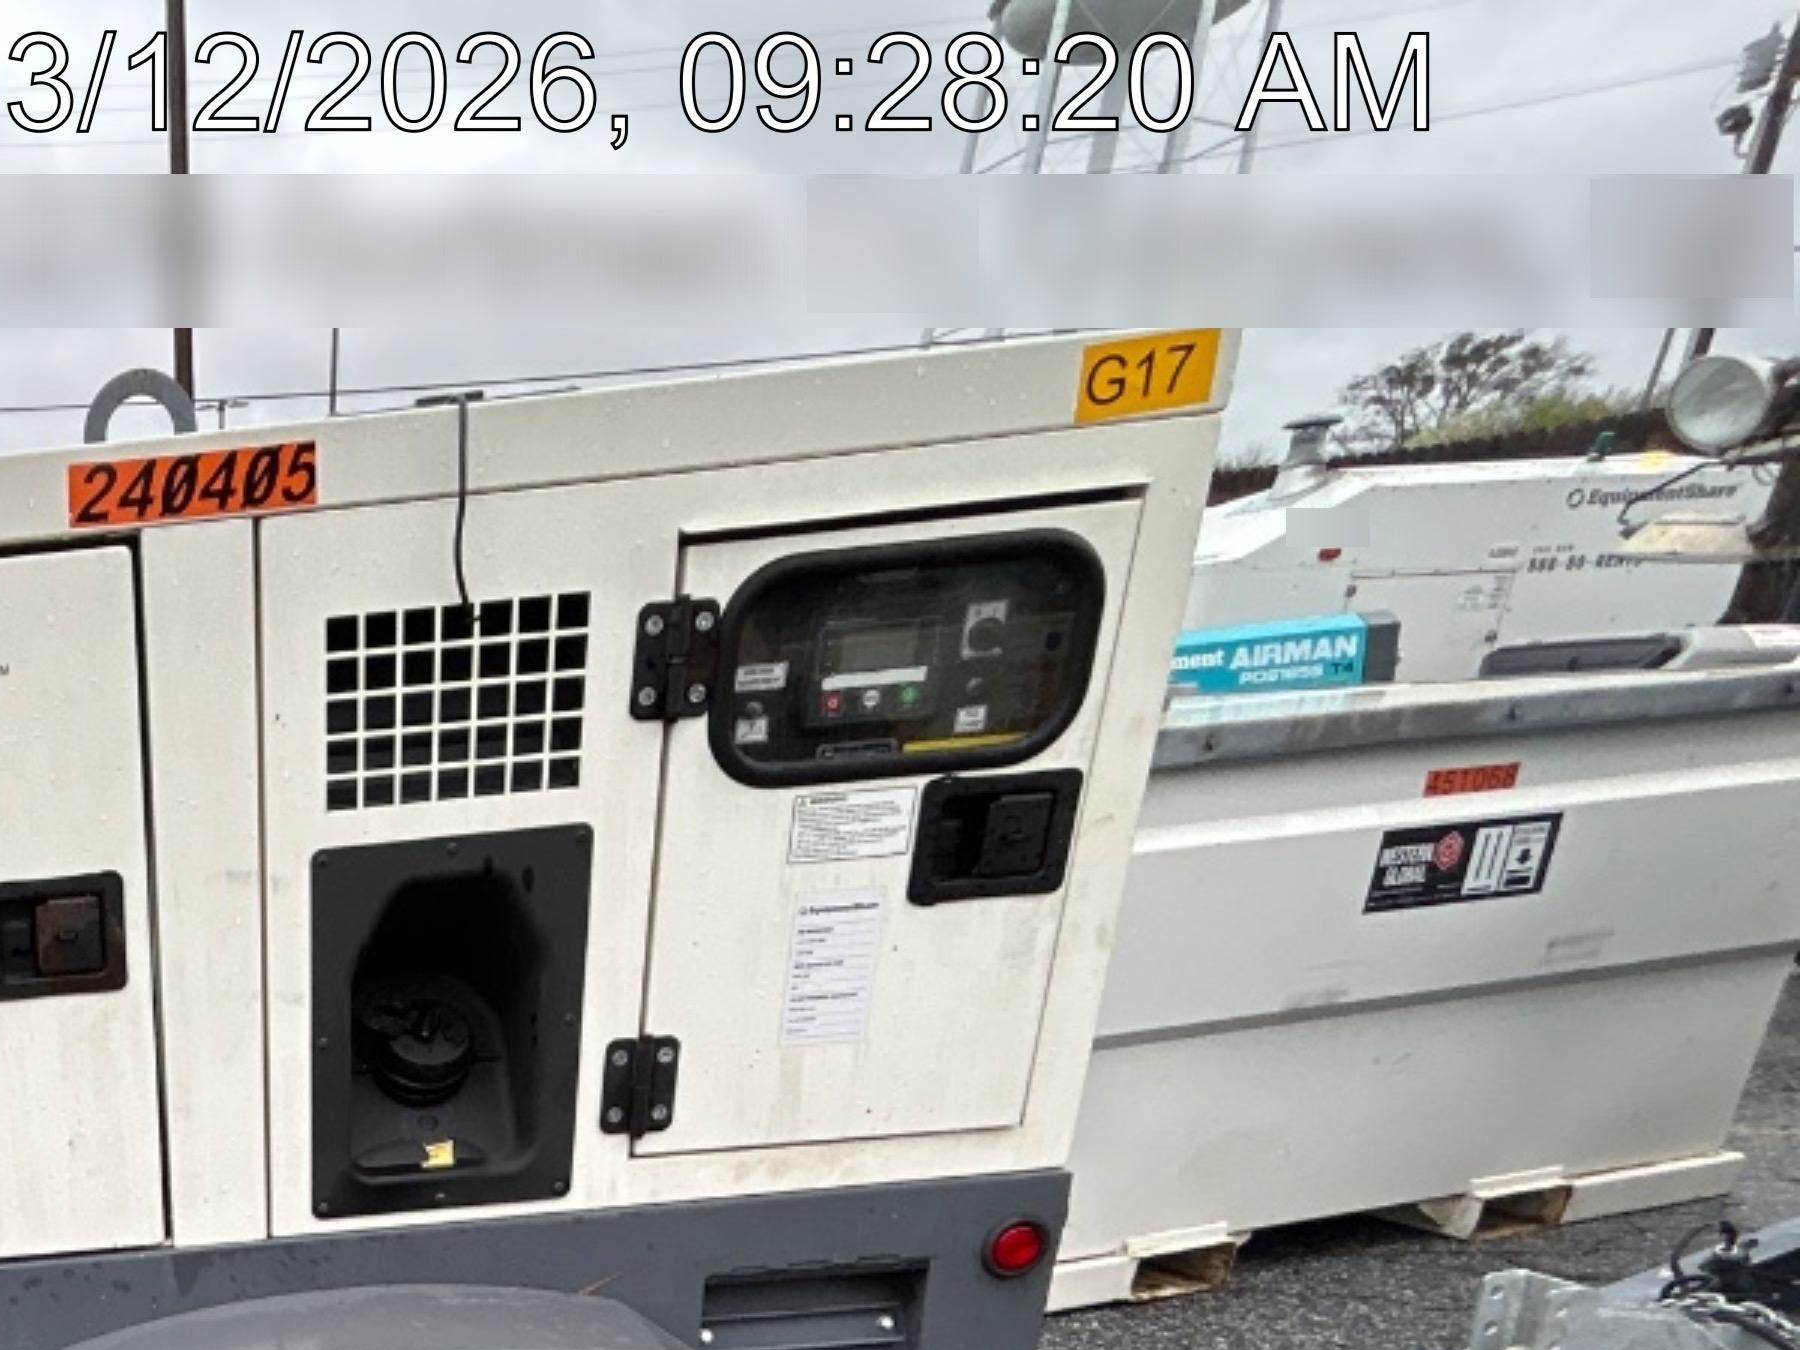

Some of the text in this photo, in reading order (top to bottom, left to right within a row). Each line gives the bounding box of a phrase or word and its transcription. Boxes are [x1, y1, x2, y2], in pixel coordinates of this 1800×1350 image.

[1086, 342, 1197, 406] G17
[76, 440, 316, 524] 240405
[1229, 633, 1359, 671] AIRMAN
